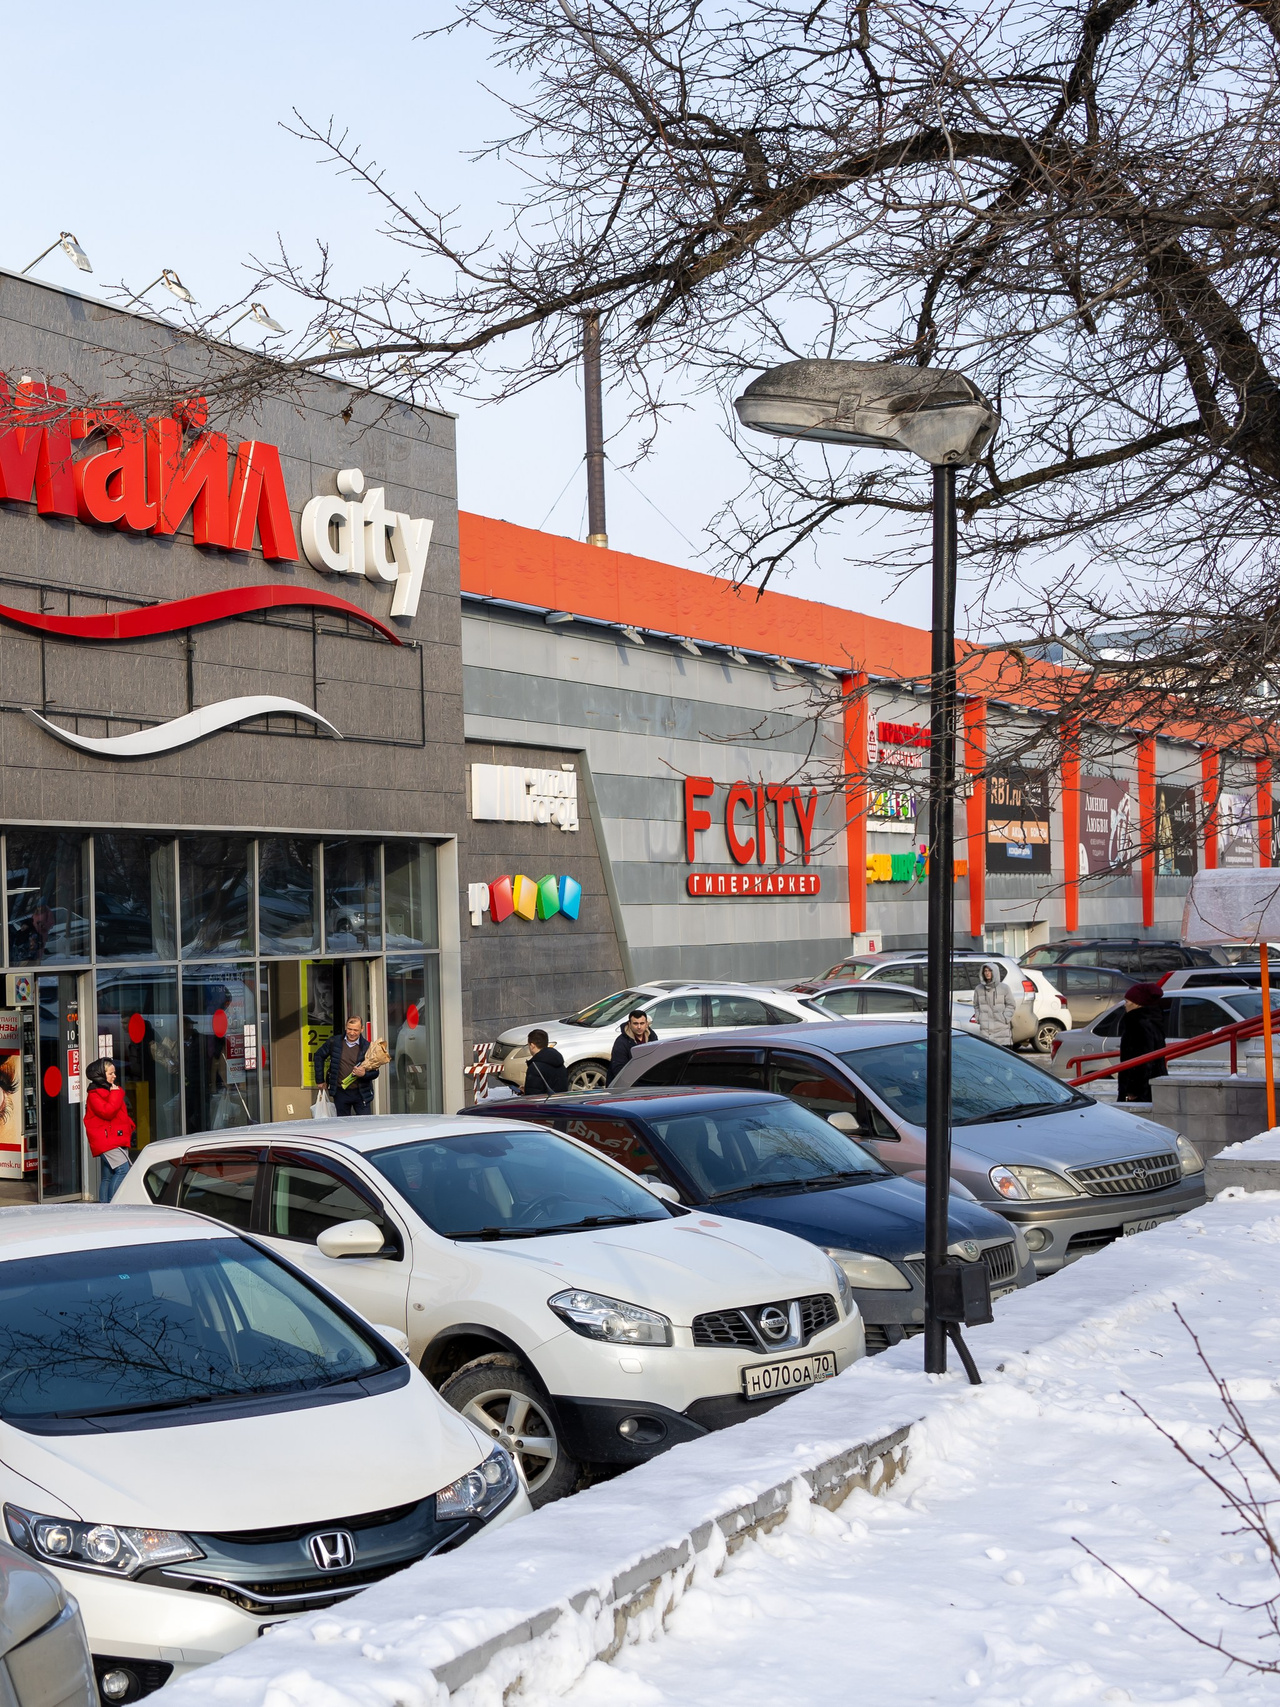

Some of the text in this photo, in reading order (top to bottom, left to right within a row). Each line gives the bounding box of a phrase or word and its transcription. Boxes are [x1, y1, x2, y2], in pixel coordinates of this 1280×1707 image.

[301, 468, 434, 618] city
[524, 763, 577, 797] ЧИТАЙ
[531, 796, 580, 832] ГОРОД
[684, 776, 818, 865] F CITY
[692, 874, 817, 893] ГИПЕРМАРКЕТ
[814, 1356, 829, 1374] 70
